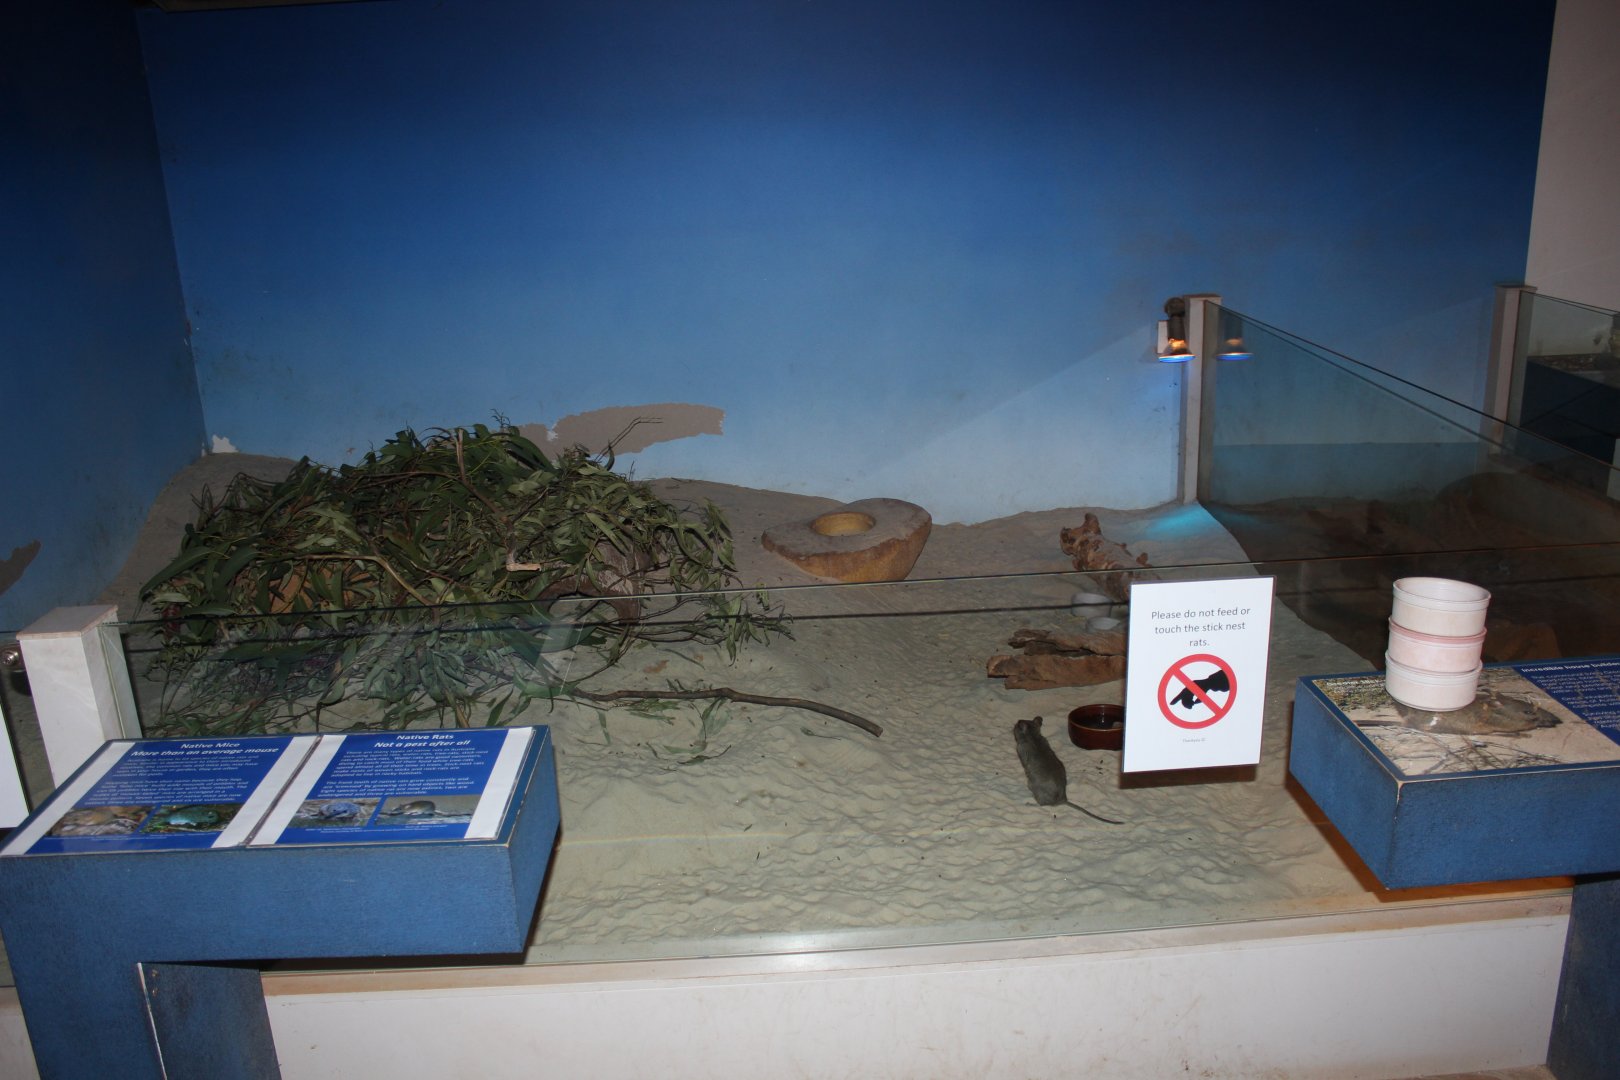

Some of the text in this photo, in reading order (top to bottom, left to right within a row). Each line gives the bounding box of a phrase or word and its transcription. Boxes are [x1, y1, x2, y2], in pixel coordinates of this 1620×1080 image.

[1151, 611, 1181, 620] Please
[1184, 610, 1196, 618] do
[1198, 609, 1214, 617] not
[1217, 607, 1238, 616] feed
[1155, 622, 1246, 634] touch the stick nest
[1189, 638, 1210, 647] rats.
